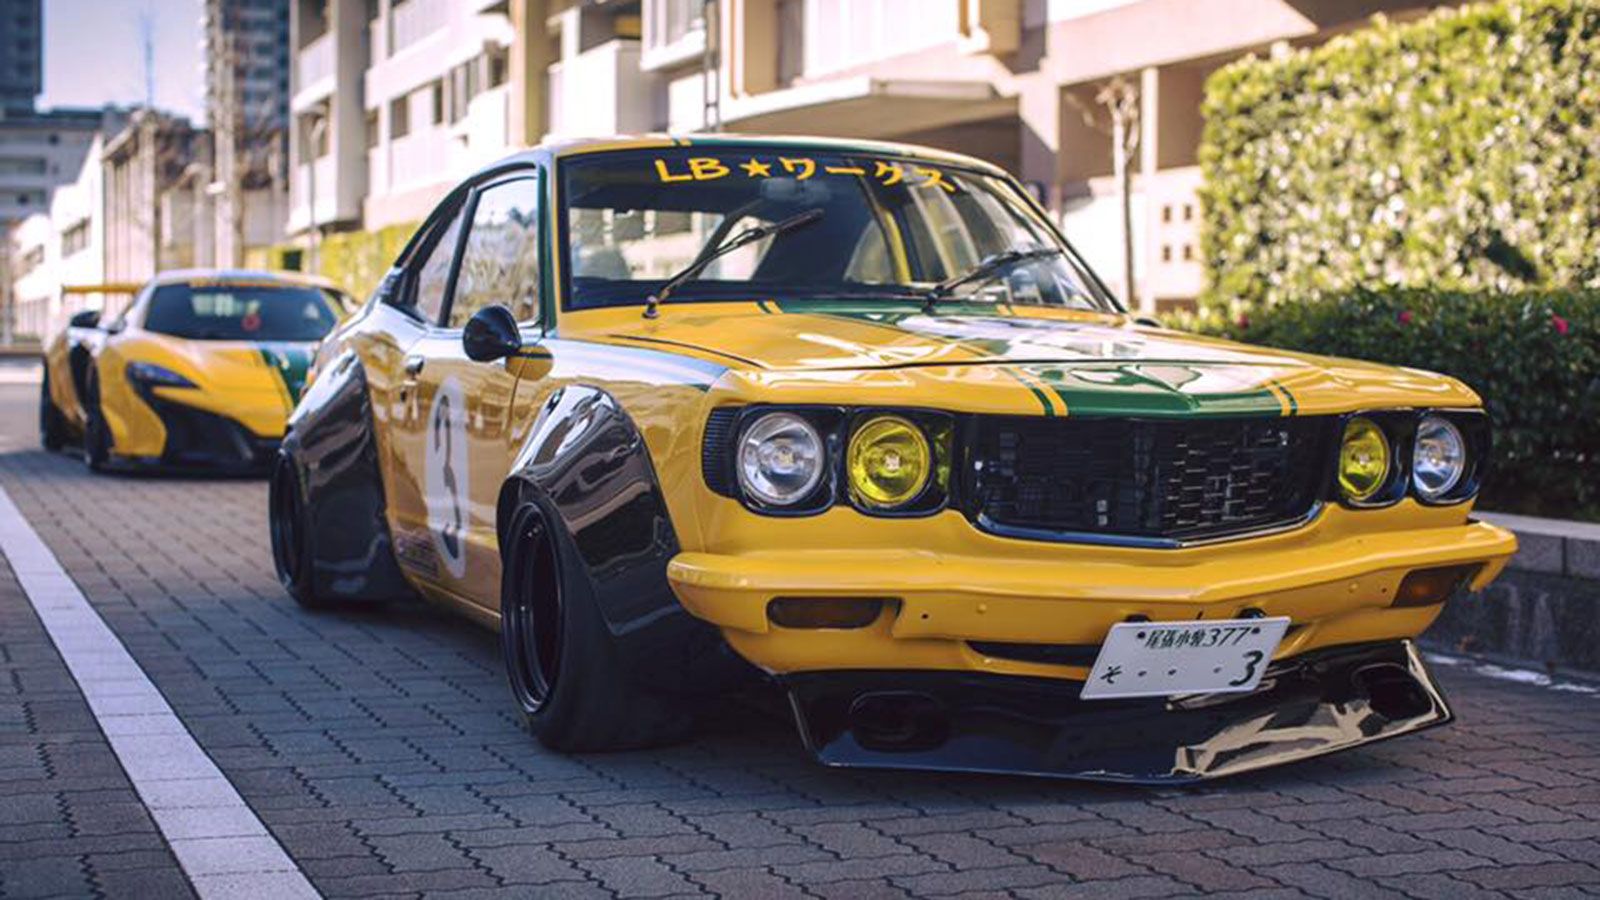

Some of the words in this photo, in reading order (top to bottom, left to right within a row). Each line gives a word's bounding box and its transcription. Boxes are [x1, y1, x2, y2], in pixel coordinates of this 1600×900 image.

[655, 158, 730, 182] LB
[778, 156, 956, 192] ワークス
[434, 394, 463, 560] 3
